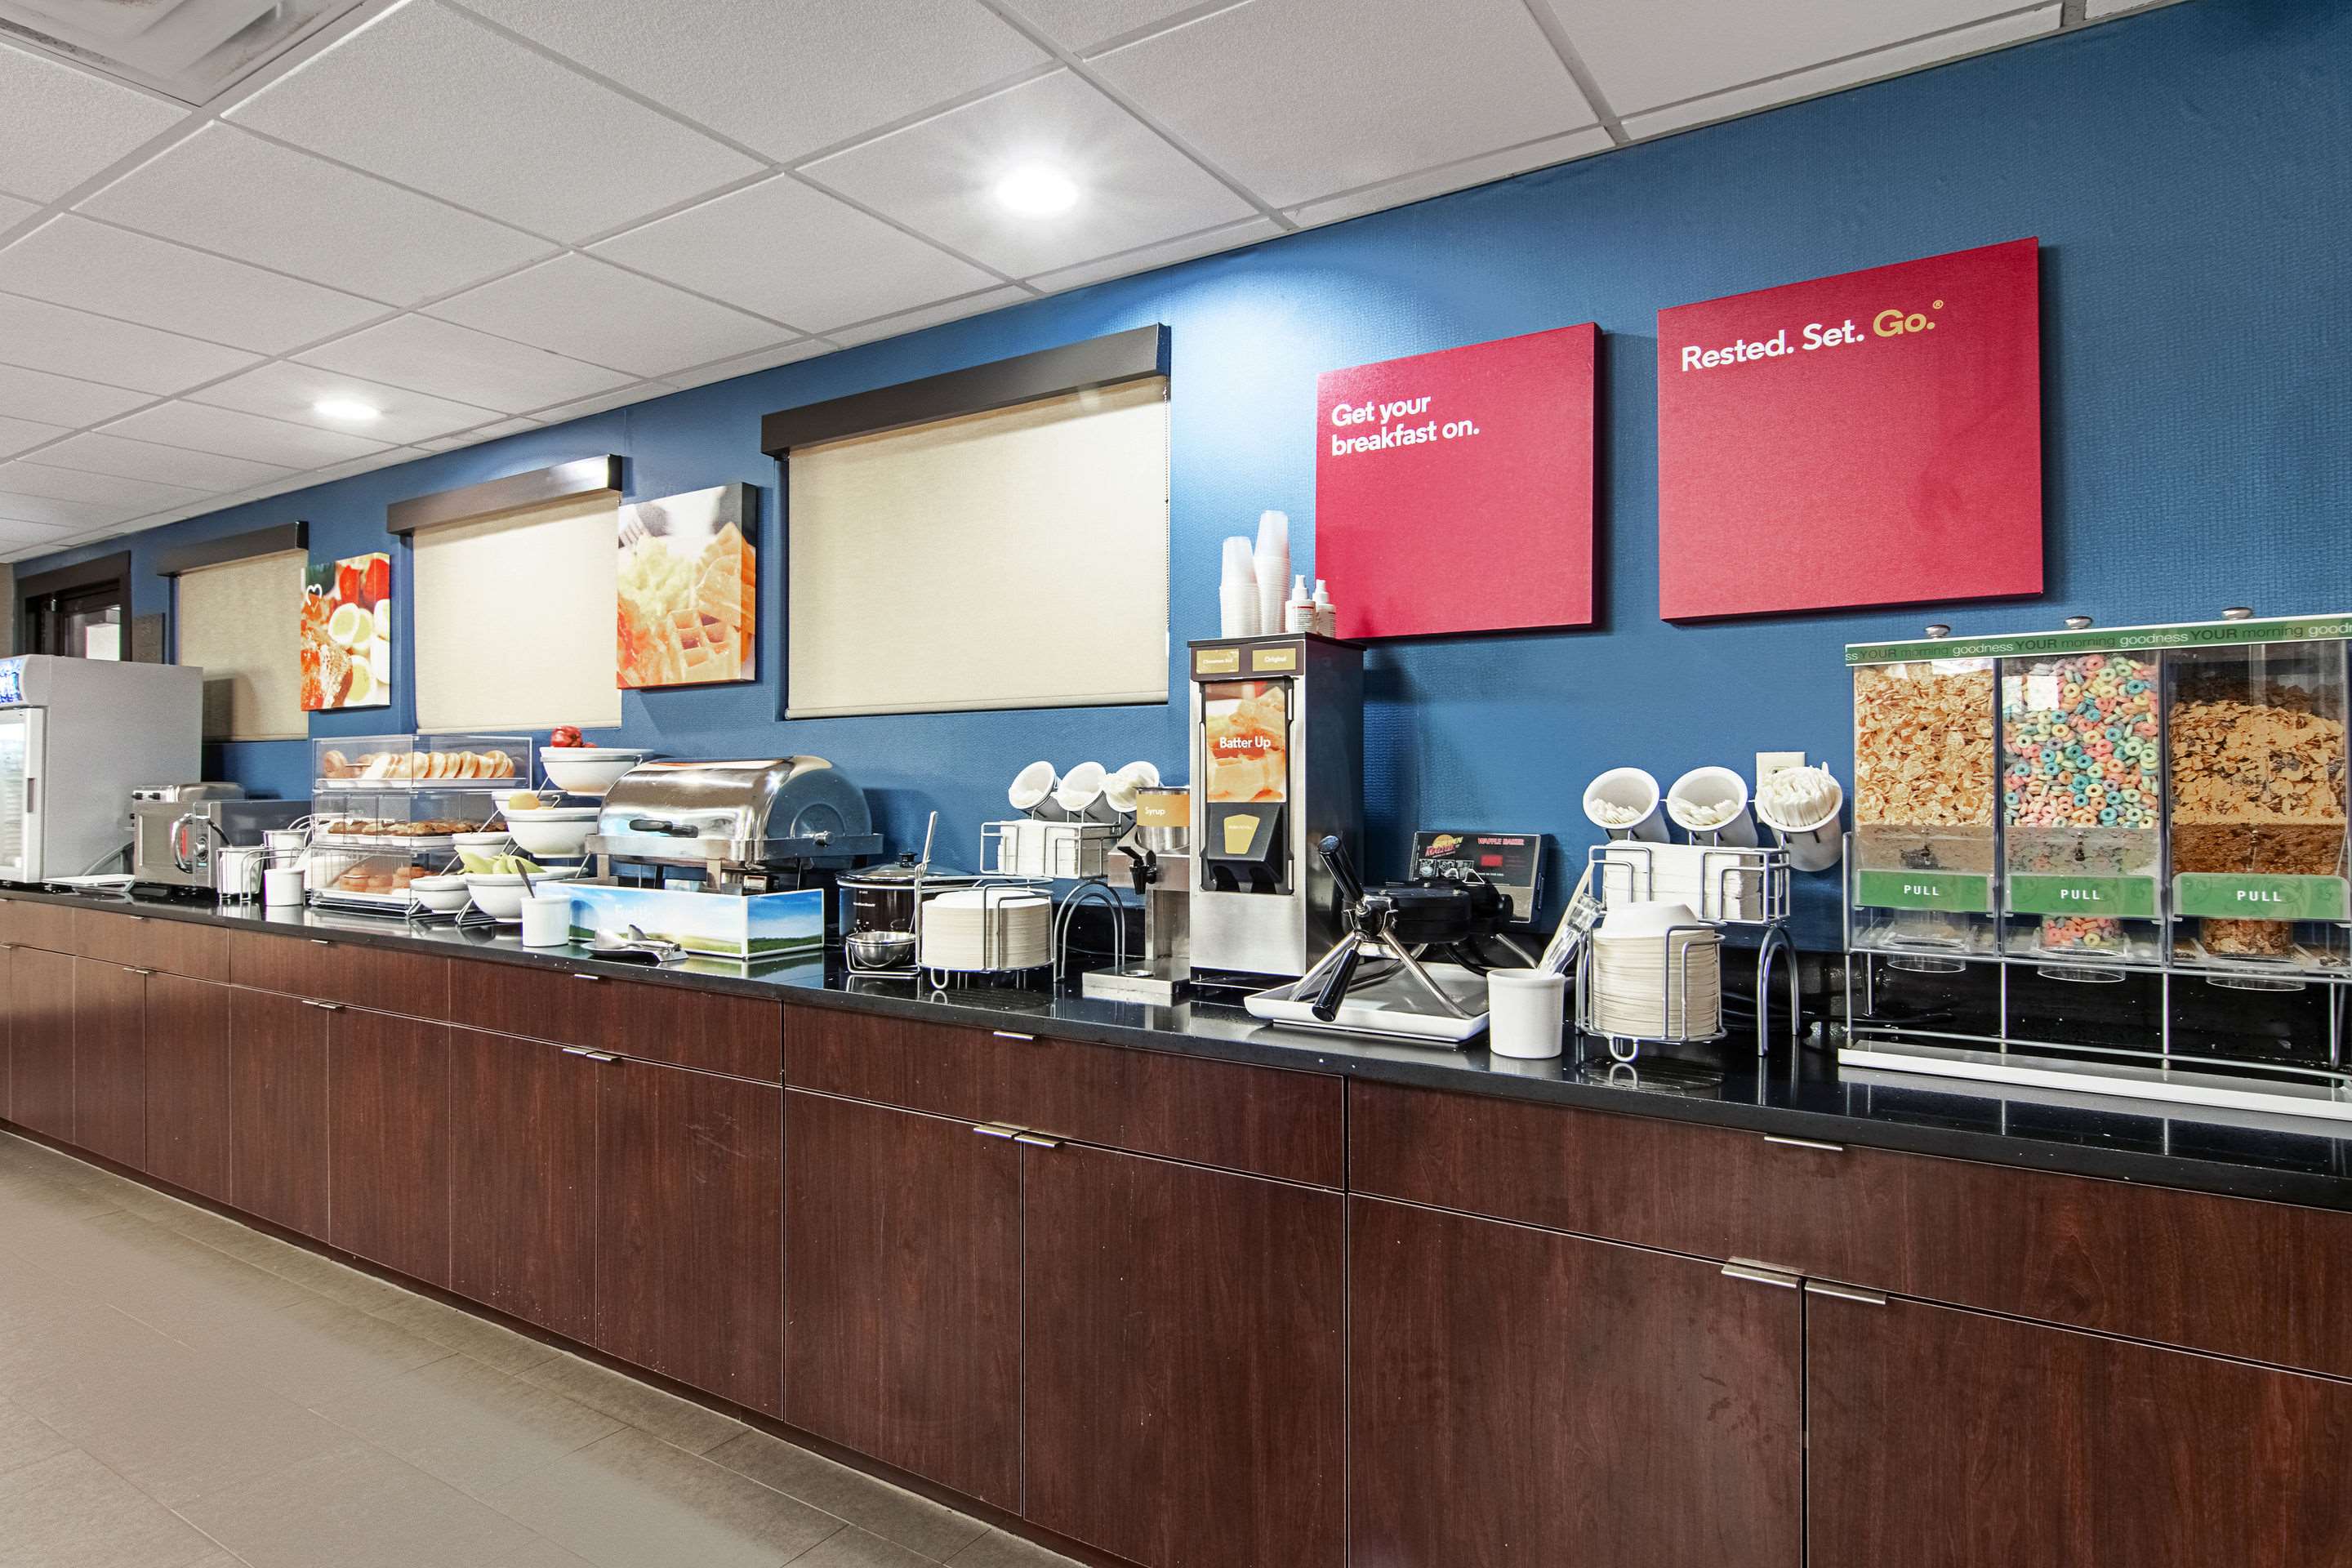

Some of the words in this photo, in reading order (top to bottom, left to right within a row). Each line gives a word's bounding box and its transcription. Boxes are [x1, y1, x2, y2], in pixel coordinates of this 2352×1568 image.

[1682, 330, 1795, 372] Rested.
[1802, 319, 1865, 350] Set.
[1331, 401, 1375, 427] Get
[1379, 396, 1432, 425] your
[1331, 420, 1437, 457] breakfast
[1441, 419, 1481, 439] on.
[1860, 648, 1896, 660] YOUR
[1900, 645, 1949, 658] morning
[1953, 642, 2014, 657] goodness
[2016, 637, 2058, 650] YOUR
[2061, 635, 2115, 649] morning
[2119, 631, 2189, 647] goodness
[2190, 628, 2238, 642] YOUR
[2241, 625, 2303, 639] morning
[1219, 737, 1253, 749] Batter
[1254, 735, 1272, 750] Up
[1144, 806, 1166, 817] Syrup
[1904, 884, 1940, 896] PULL
[2060, 889, 2100, 900] PULL
[2237, 890, 2283, 902] PULL
